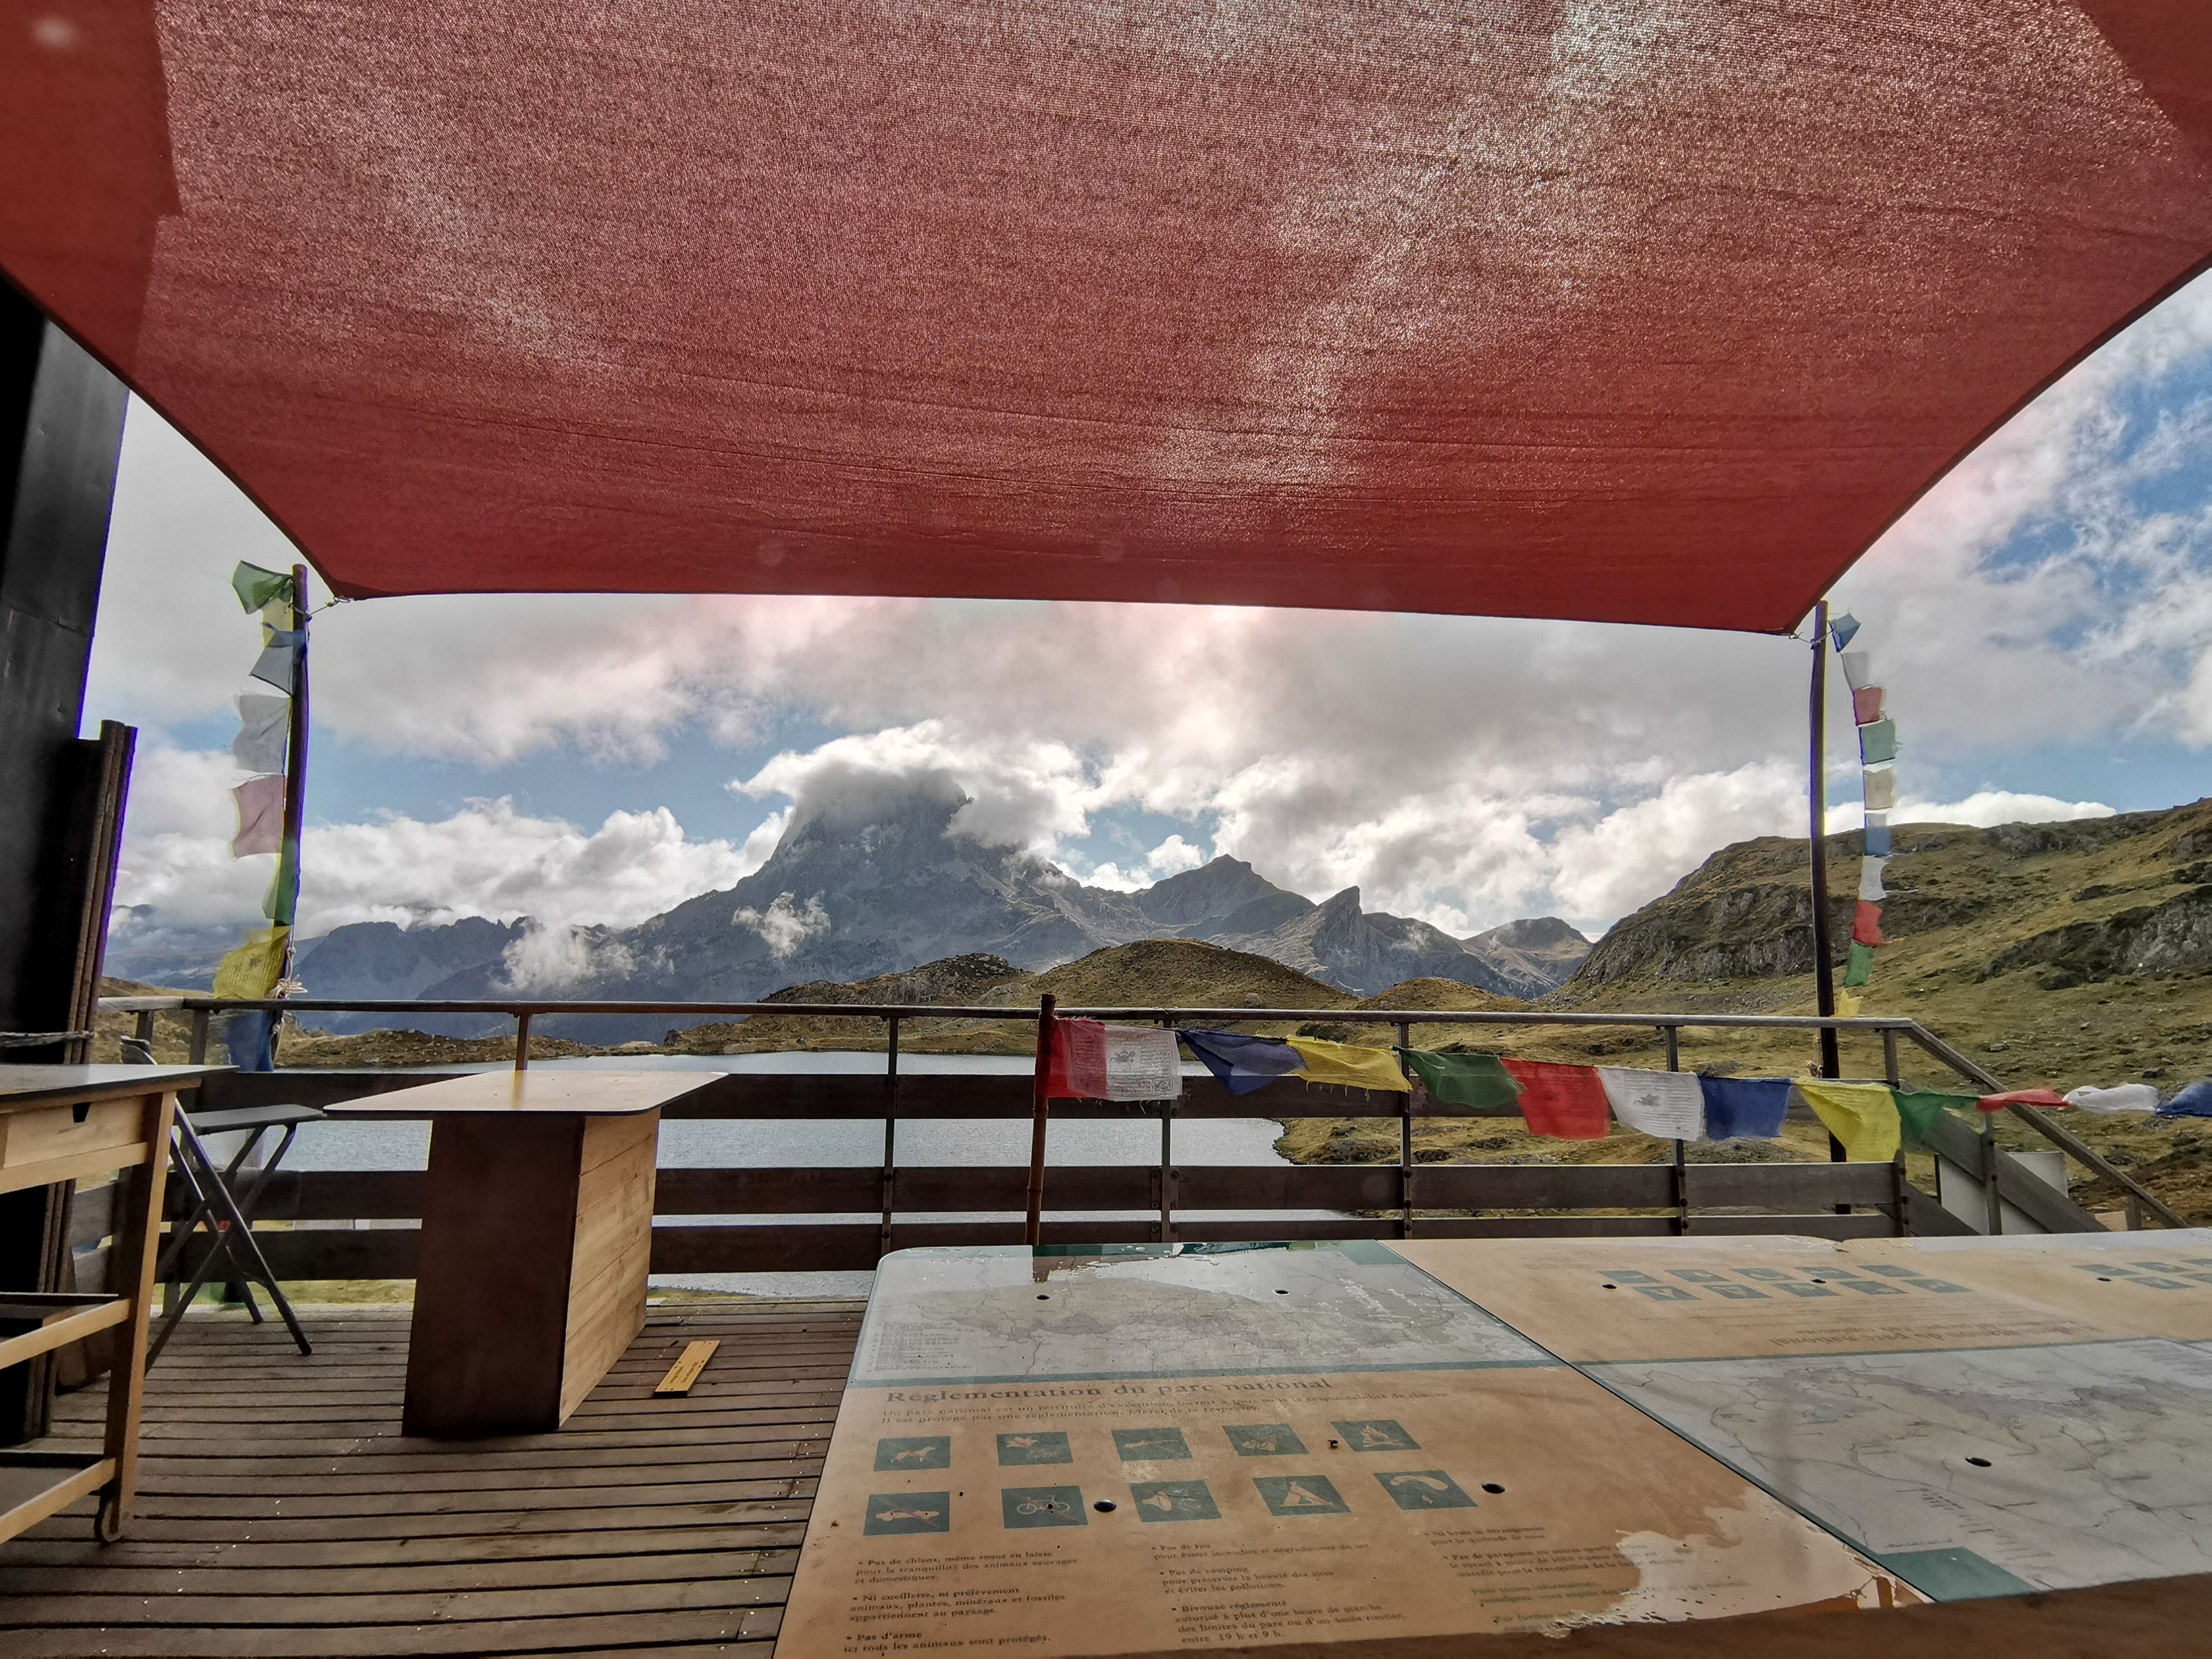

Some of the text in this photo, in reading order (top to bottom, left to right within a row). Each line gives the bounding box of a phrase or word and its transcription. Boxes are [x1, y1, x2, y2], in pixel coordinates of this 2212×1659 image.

[1113, 1384, 1146, 1395] du
[1157, 1384, 1215, 1396] parc
[1225, 1378, 1333, 1391] national
[940, 1406, 991, 1415] national
[953, 1587, 1019, 1598] prélèvement
[956, 1598, 1008, 1606] minéraux
[849, 1611, 929, 1622] appartiennent
[1233, 1612, 1256, 1620] plus
[1343, 1604, 1381, 1613] marche
[1259, 1621, 1283, 1630] parc
[1219, 1633, 1232, 1641] 19
[863, 1644, 888, 1652] tous
[913, 1640, 963, 1649] animaux
[999, 1635, 1051, 1645] protégés.
